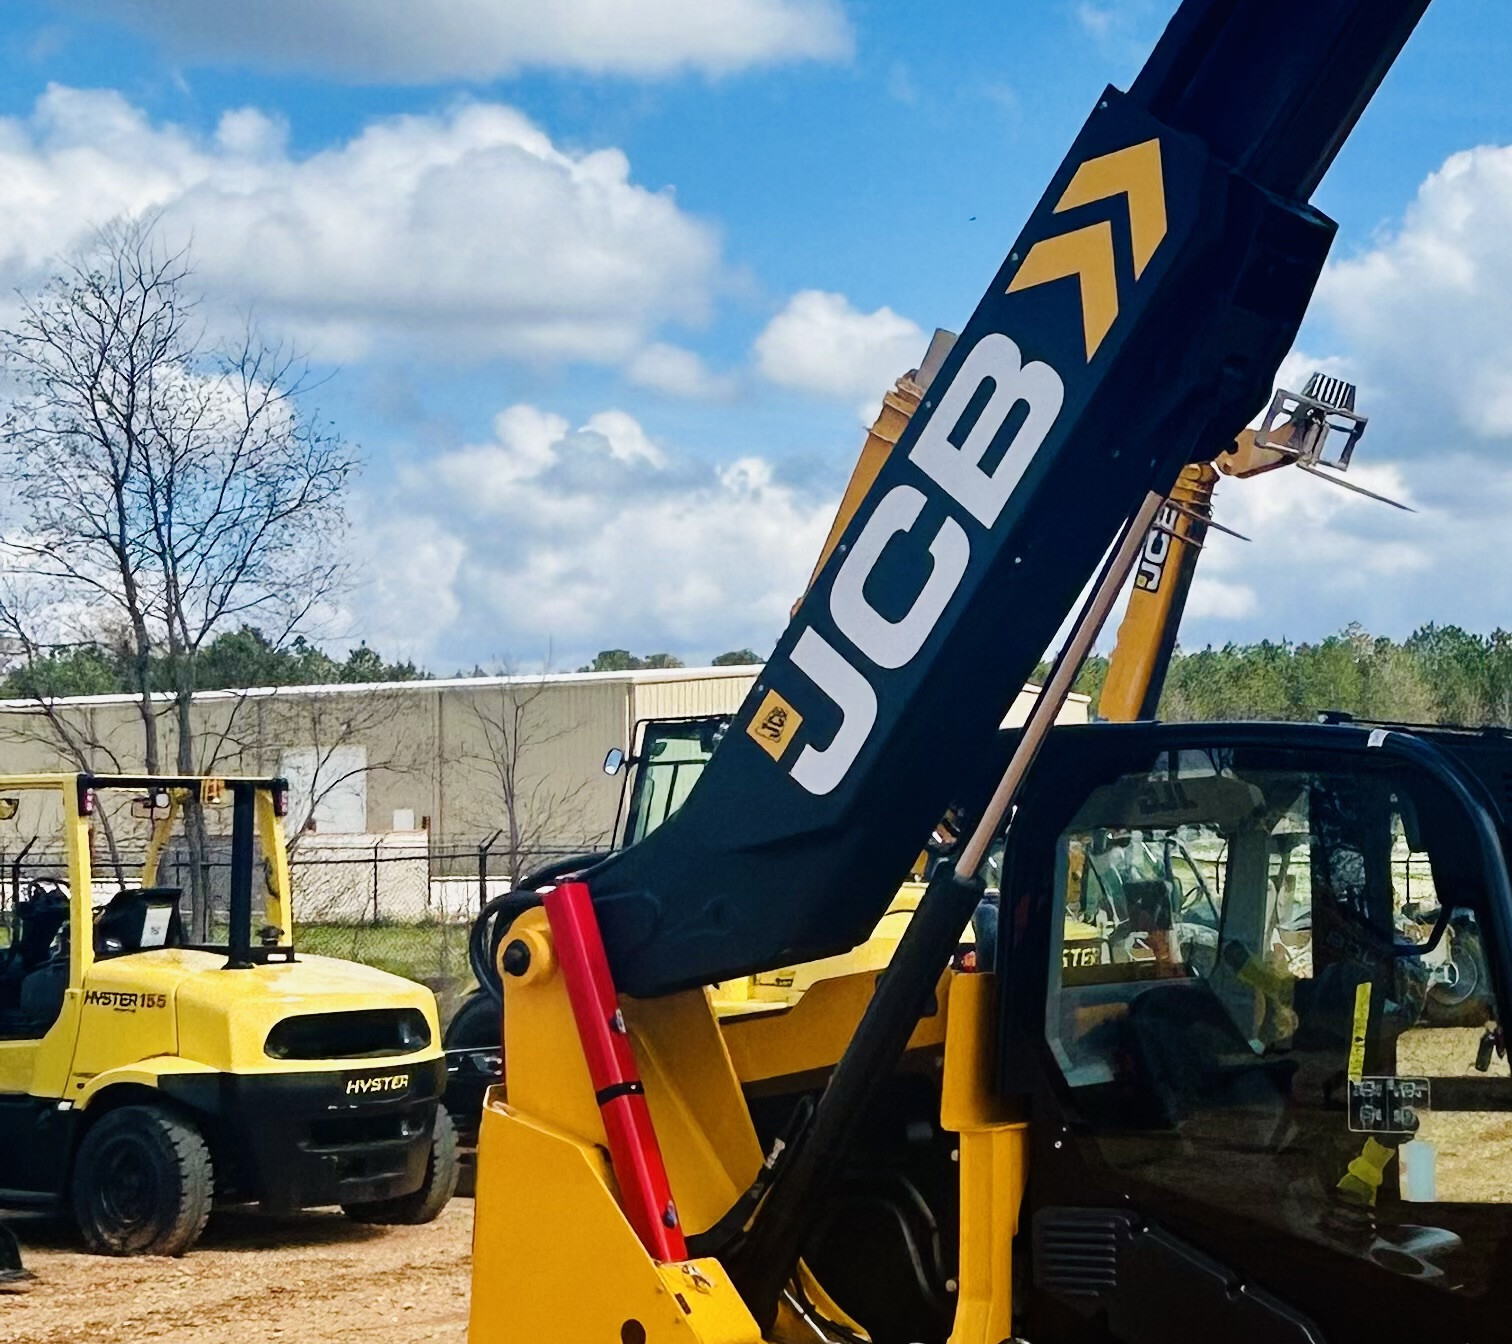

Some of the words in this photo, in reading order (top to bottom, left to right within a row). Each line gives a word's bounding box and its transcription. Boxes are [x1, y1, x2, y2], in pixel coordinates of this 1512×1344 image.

[790, 332, 1065, 797] JCB
[84, 991, 138, 1006] HYSTER
[345, 1074, 409, 1095] HYSTER
